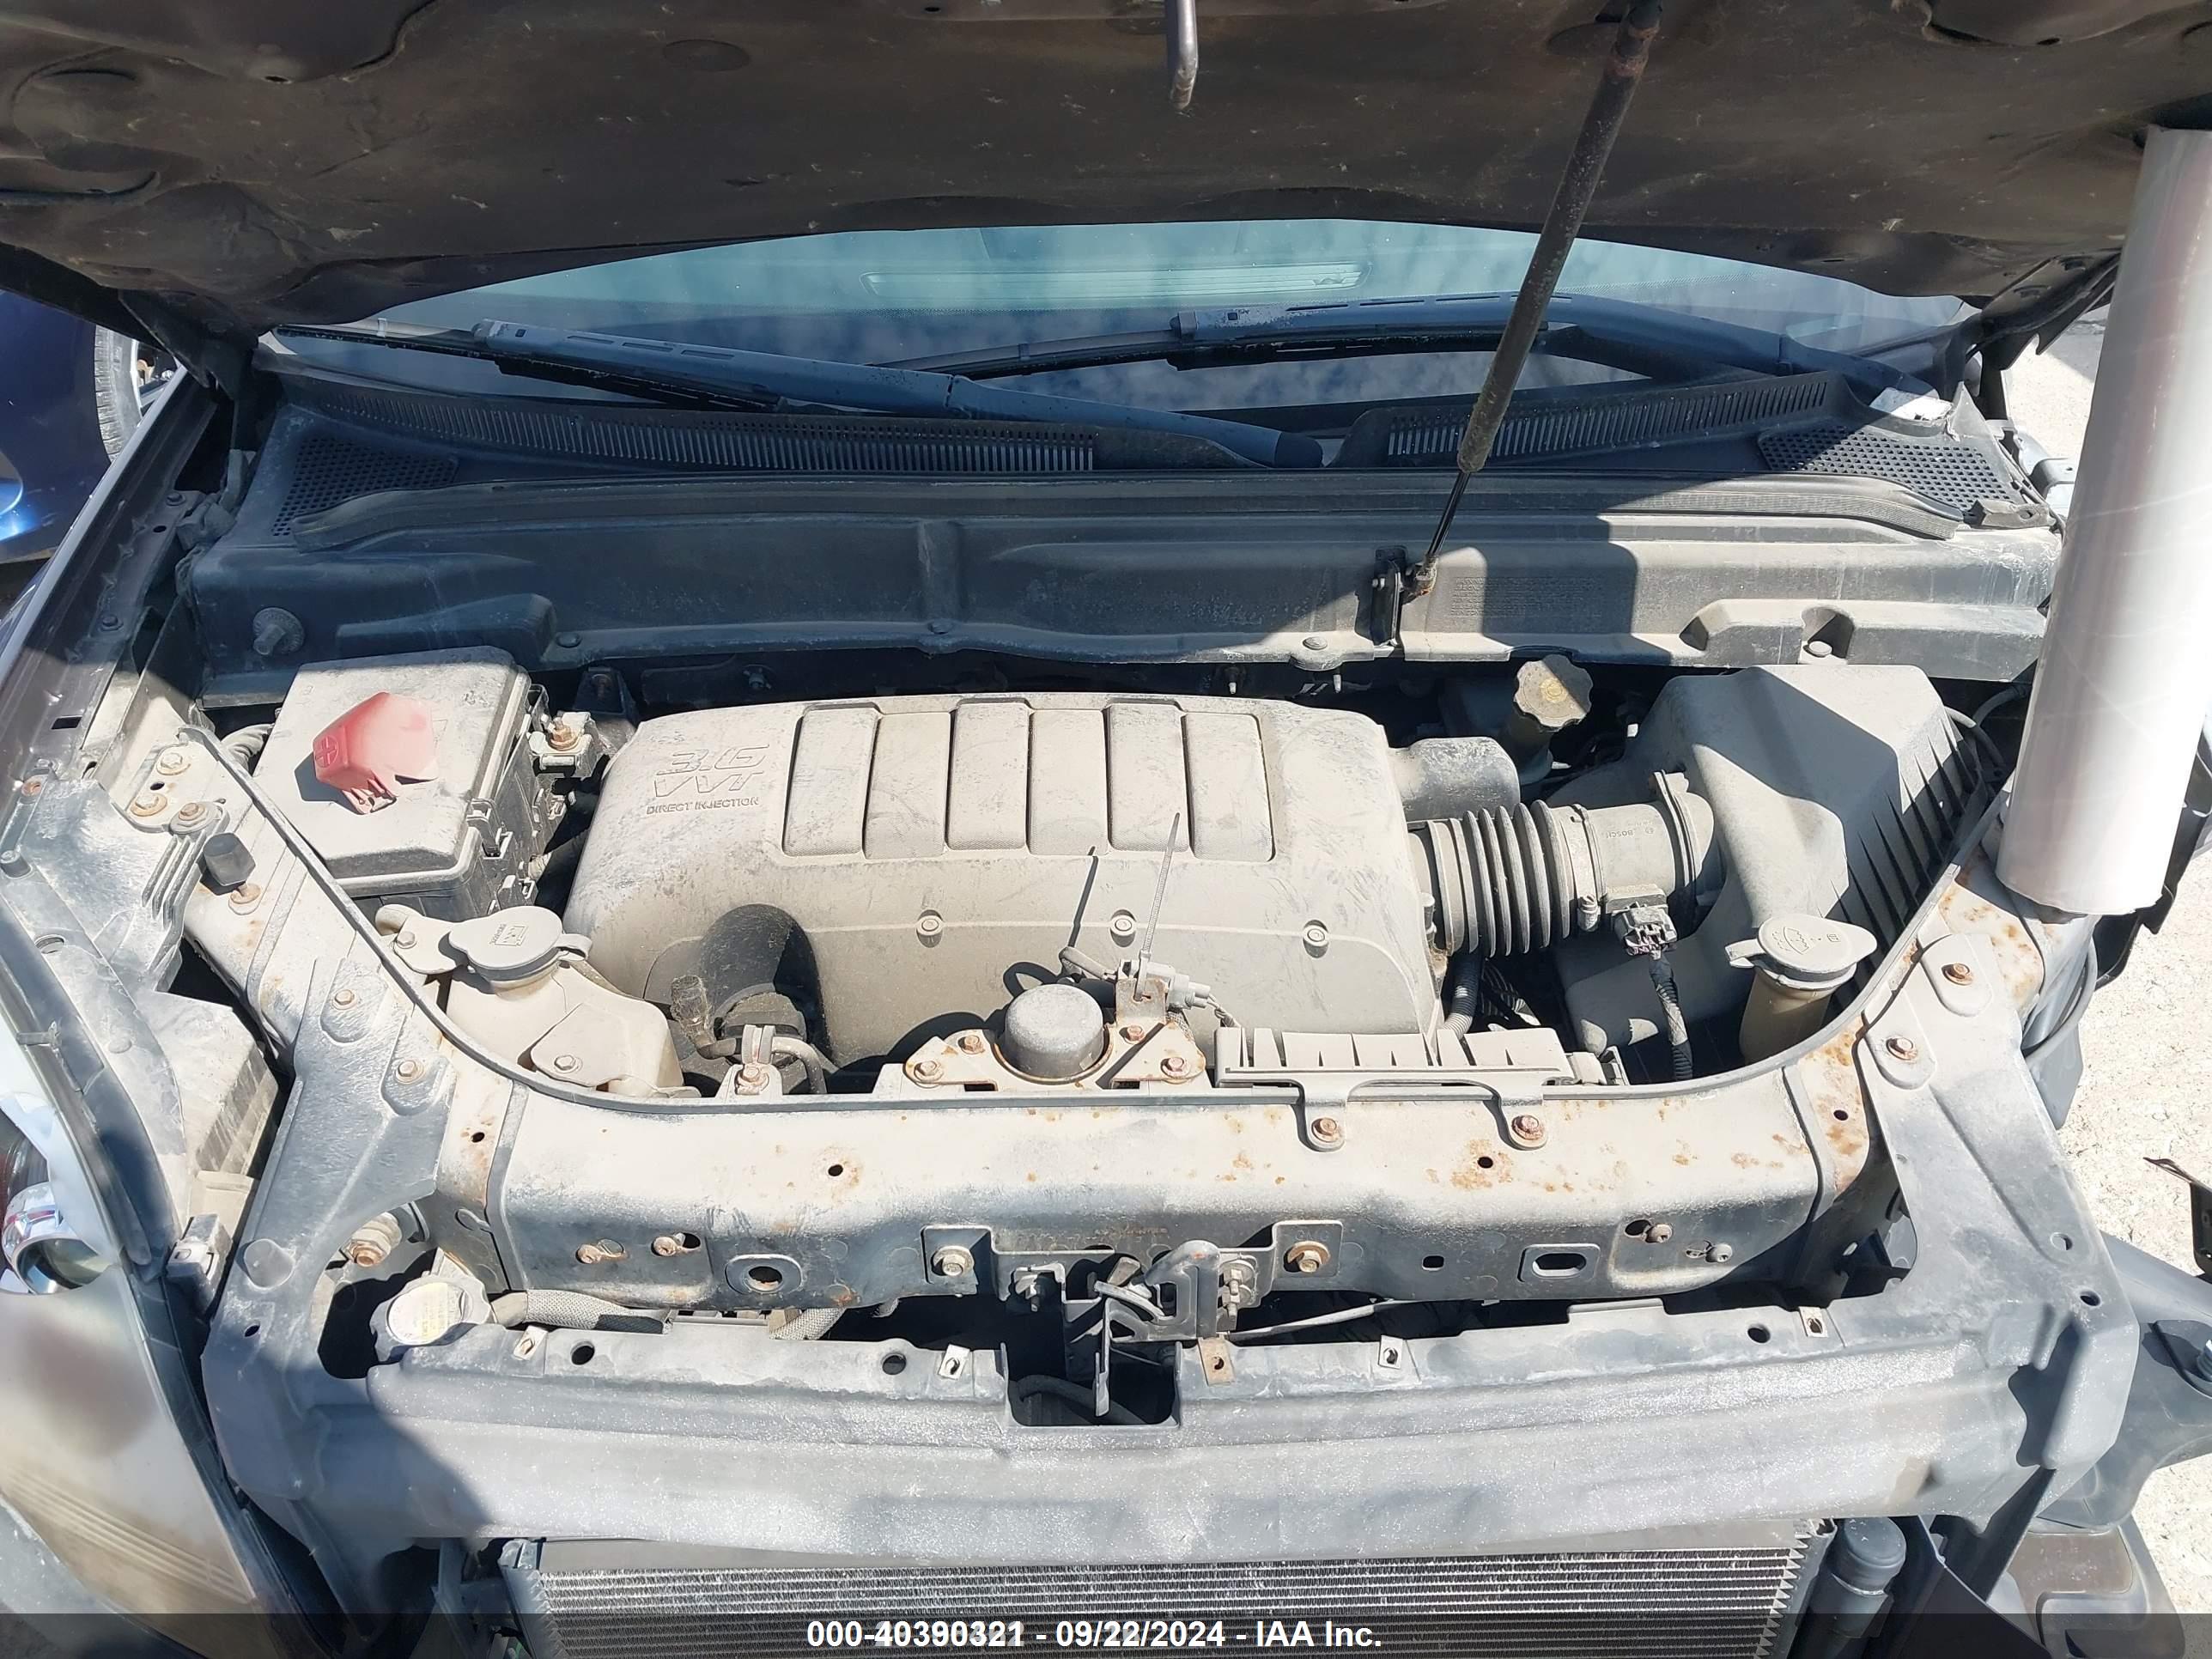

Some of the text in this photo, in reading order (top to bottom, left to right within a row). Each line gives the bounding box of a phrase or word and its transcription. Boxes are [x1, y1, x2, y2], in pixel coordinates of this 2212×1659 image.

[655, 744, 770, 775] 3.6
[653, 770, 765, 798] VVT
[646, 796, 760, 815] DIRECT INJECTION
